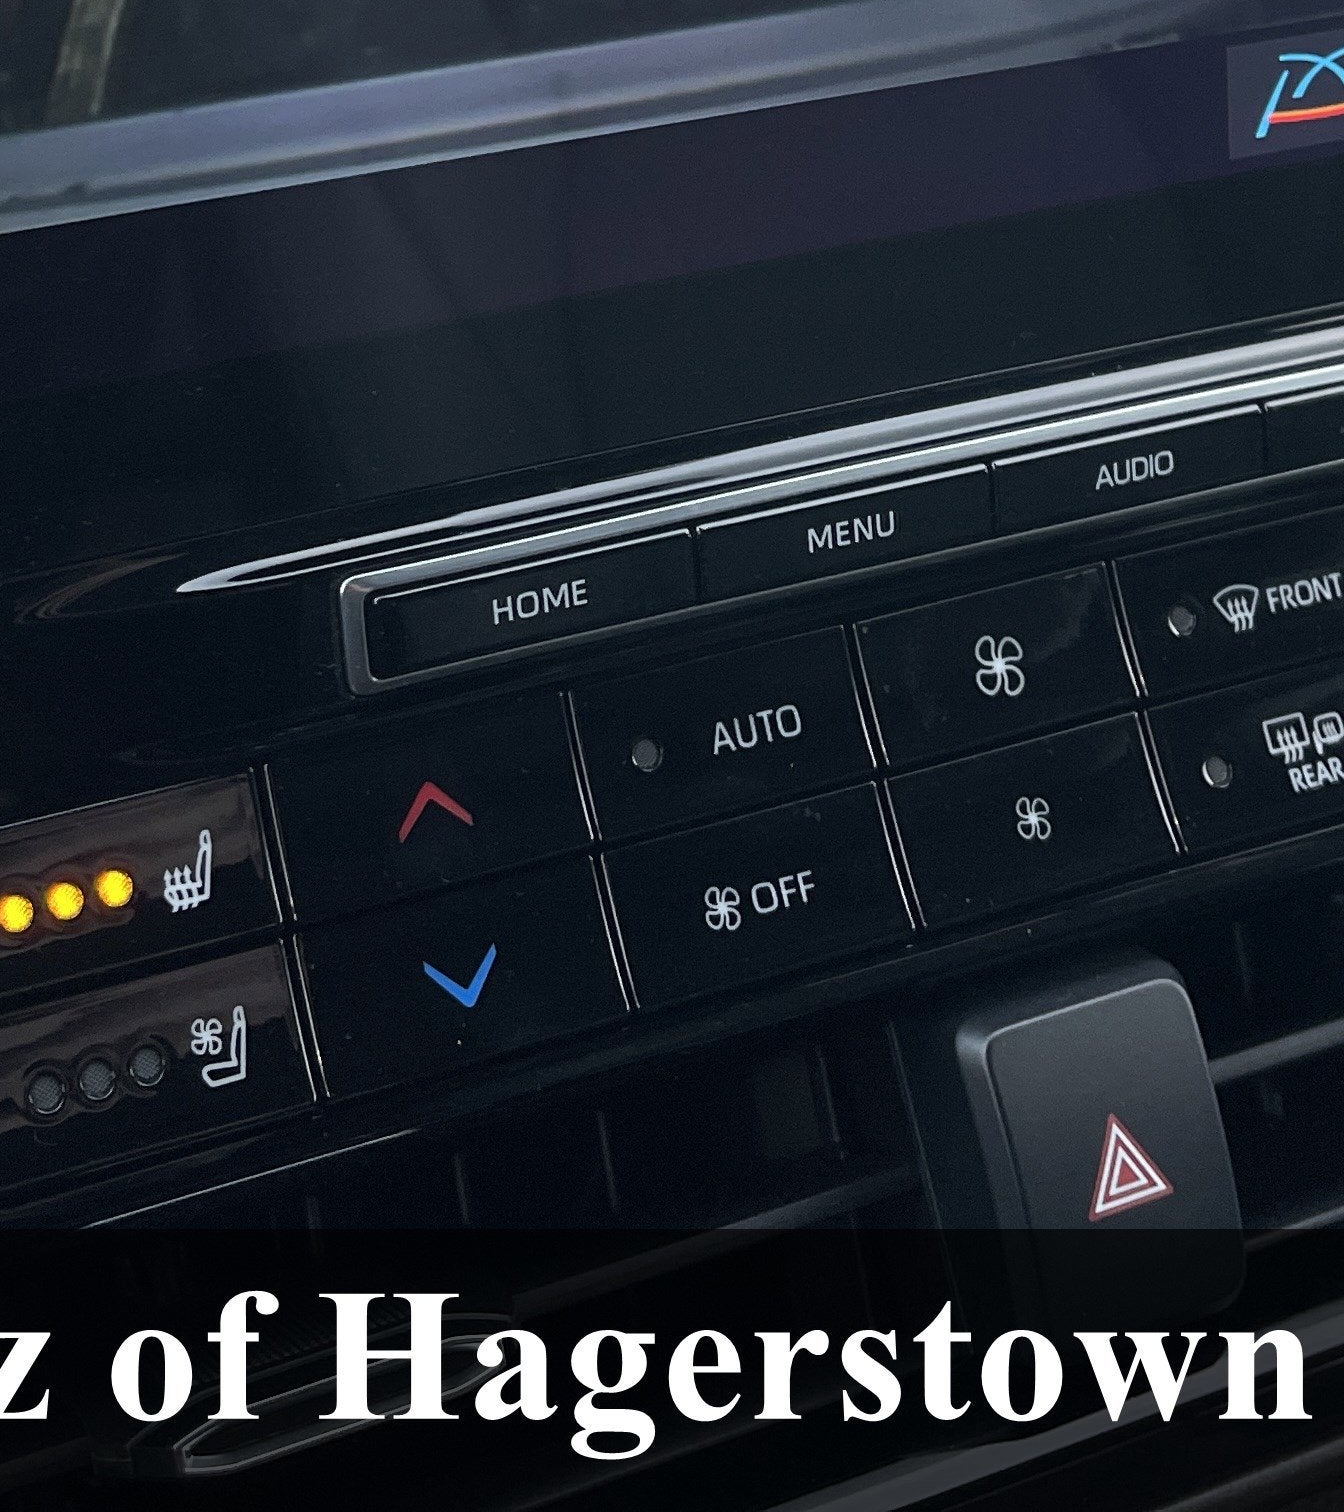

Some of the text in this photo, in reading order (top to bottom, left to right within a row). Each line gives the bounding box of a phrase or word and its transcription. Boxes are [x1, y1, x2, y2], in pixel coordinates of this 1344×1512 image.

[1095, 450, 1175, 491] AUDIO
[806, 511, 896, 554] MENU
[491, 578, 589, 625] HOME
[1266, 573, 1343, 613] FRONT
[712, 704, 802, 755] AUTO
[751, 870, 816, 914] OFF
